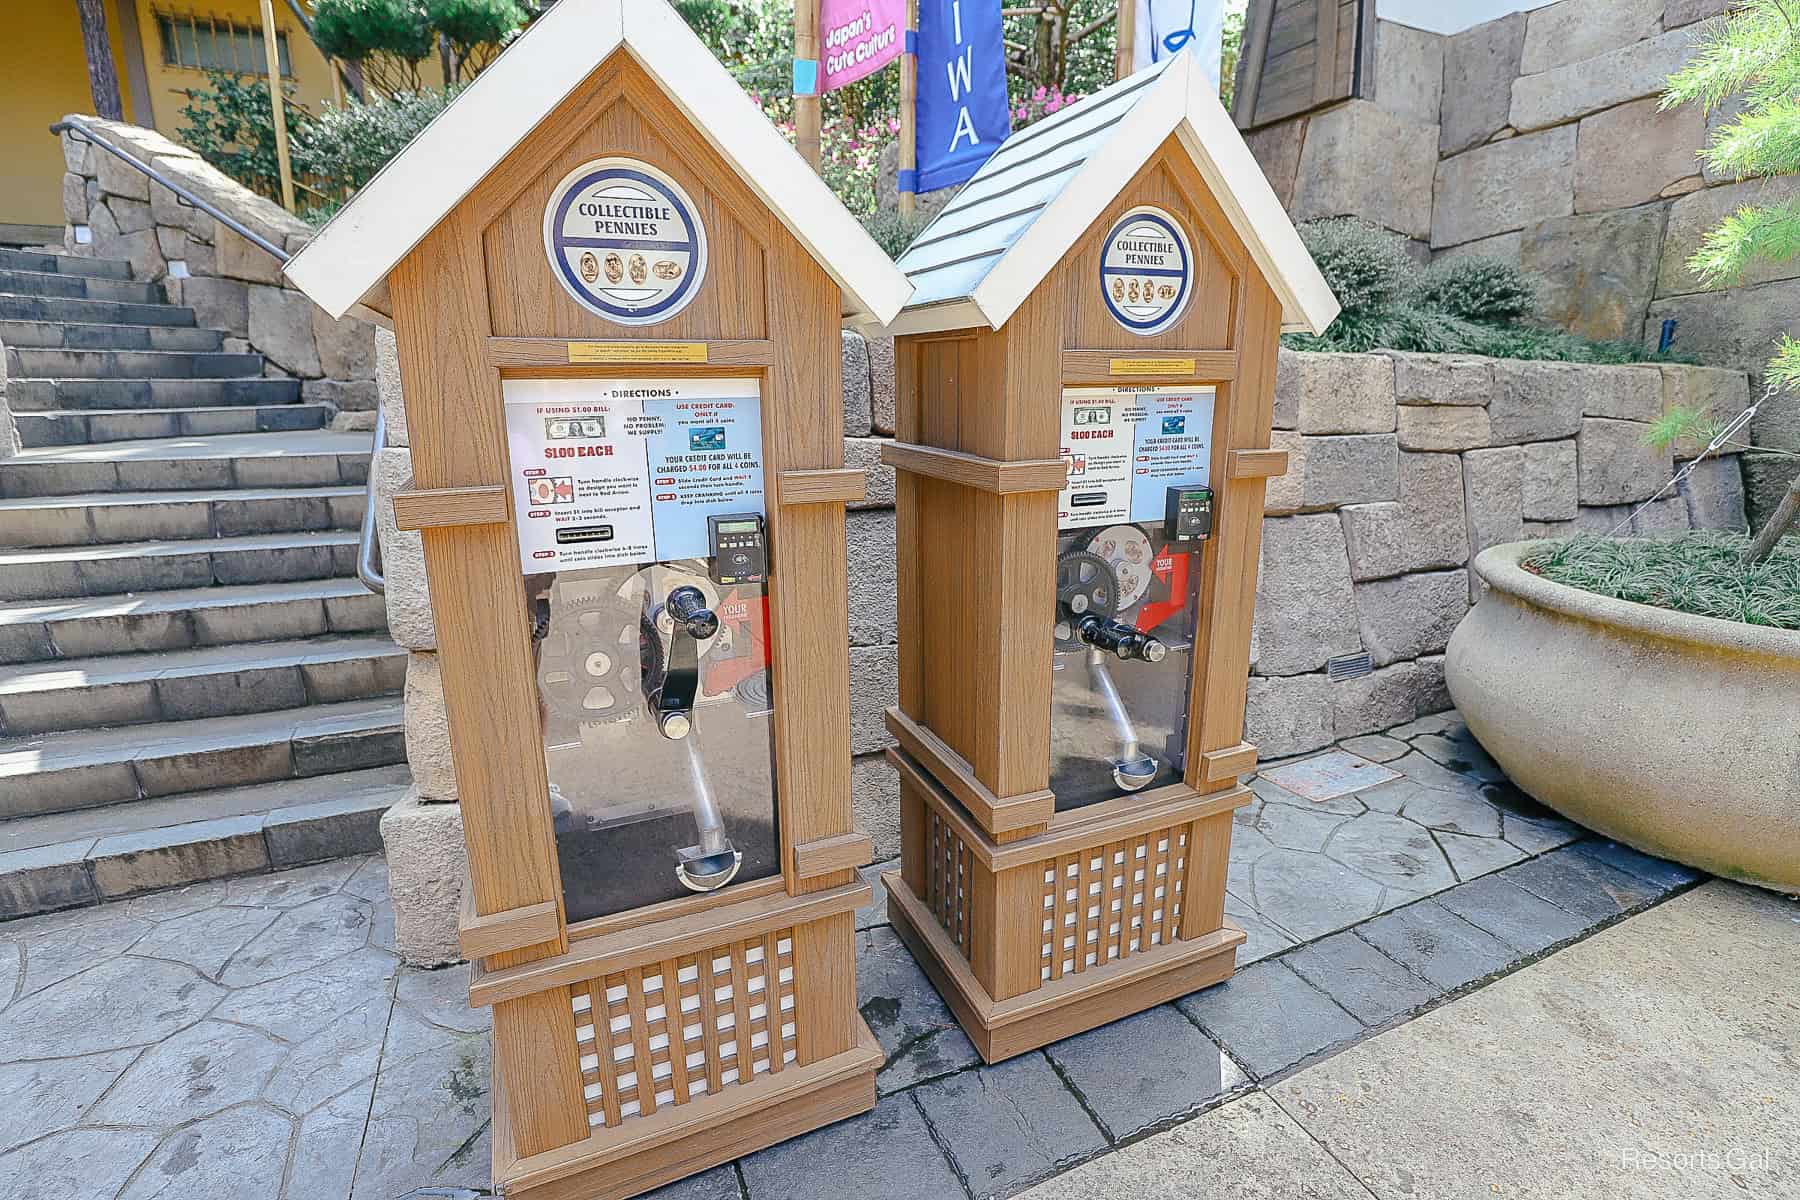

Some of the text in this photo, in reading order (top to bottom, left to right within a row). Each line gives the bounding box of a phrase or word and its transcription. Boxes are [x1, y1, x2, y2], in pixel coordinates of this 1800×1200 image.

[825, 11, 872, 49] Japan's
[826, 24, 896, 75] Cute Culture
[579, 203, 671, 221] COLLECTIBLE
[595, 220, 658, 236] PENNIES
[1116, 241, 1174, 253] COLLECTIBLE
[1125, 254, 1165, 265] PENNIES
[612, 389, 671, 398] DIRECTIONS
[1092, 430, 1114, 440] EACH
[578, 446, 614, 457] EACH
[665, 456, 683, 464] YOUR
[744, 452, 752, 460] BE
[722, 604, 747, 614] YOUR
